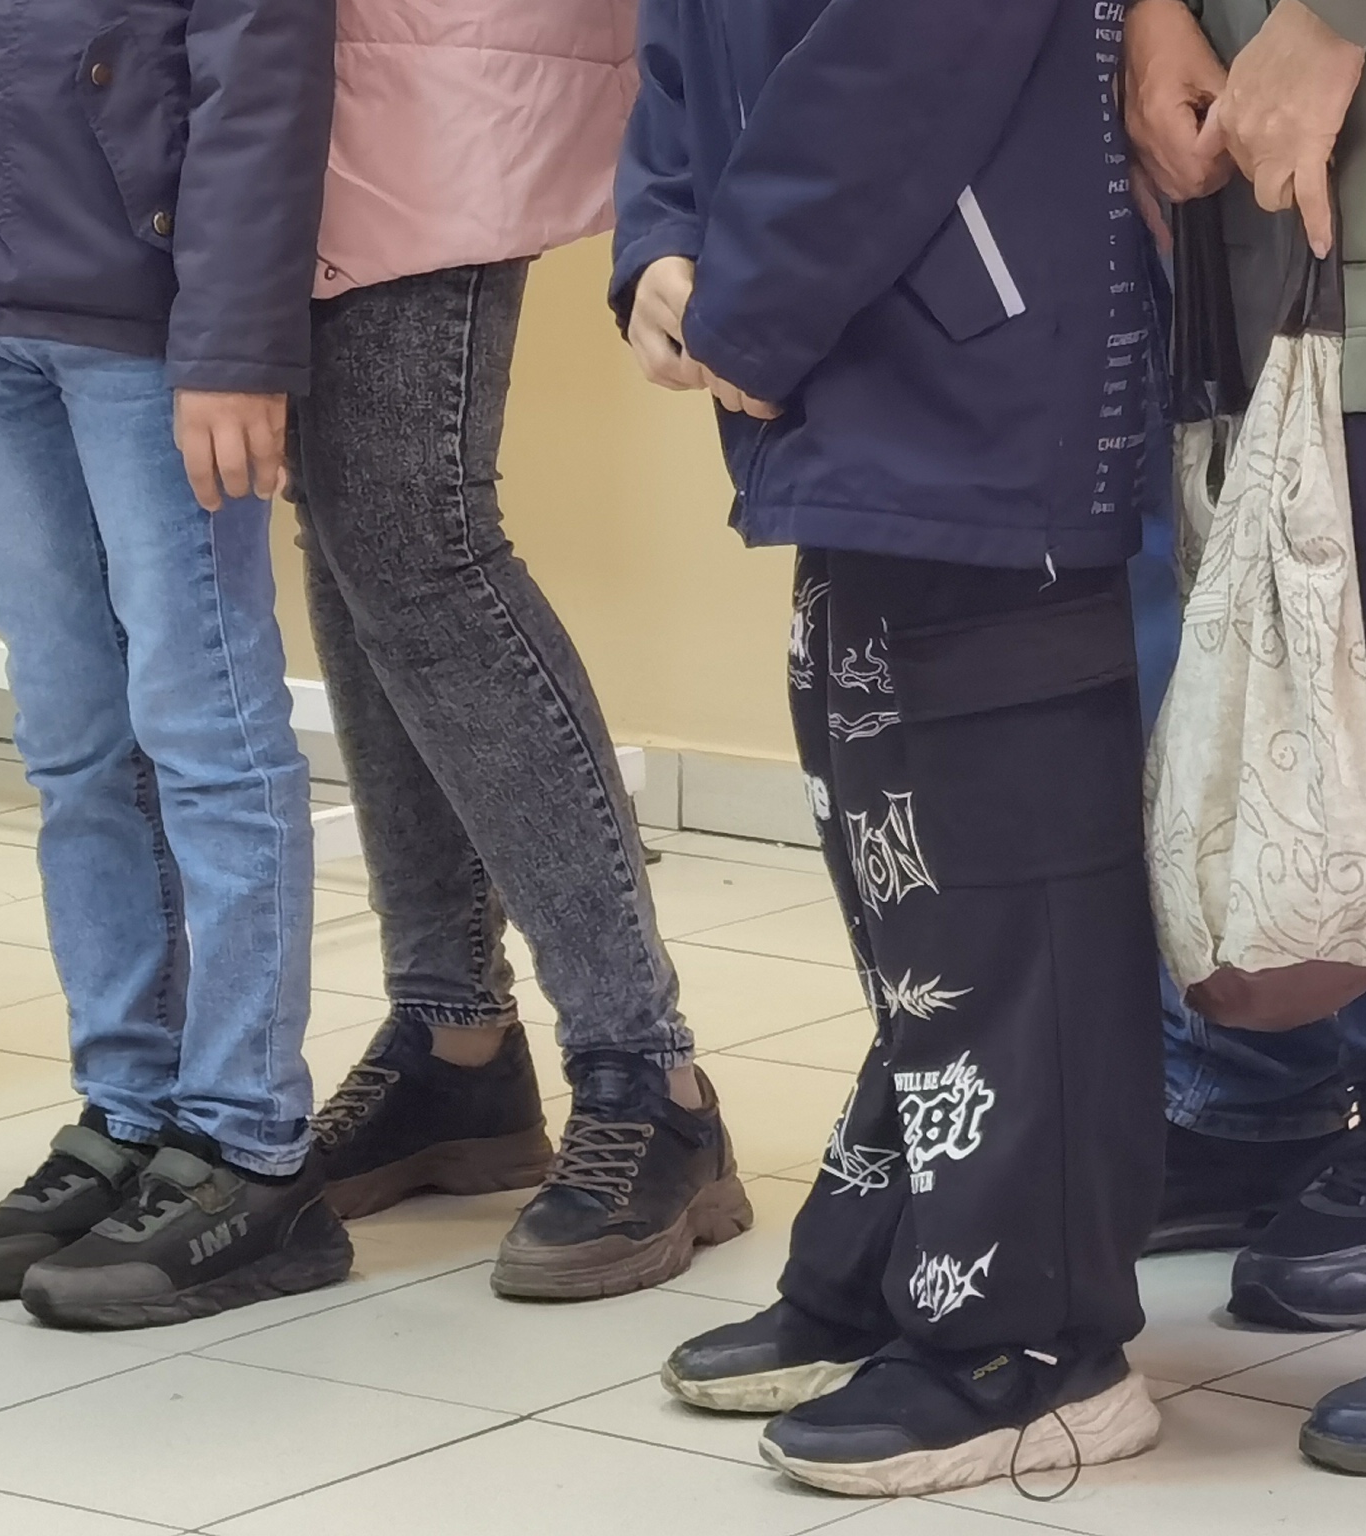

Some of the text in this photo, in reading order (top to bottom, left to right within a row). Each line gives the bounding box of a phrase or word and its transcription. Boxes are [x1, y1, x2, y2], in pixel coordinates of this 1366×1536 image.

[894, 1071, 922, 1092] WILL
[940, 1049, 978, 1086] the
[188, 1210, 251, 1266] JMT
